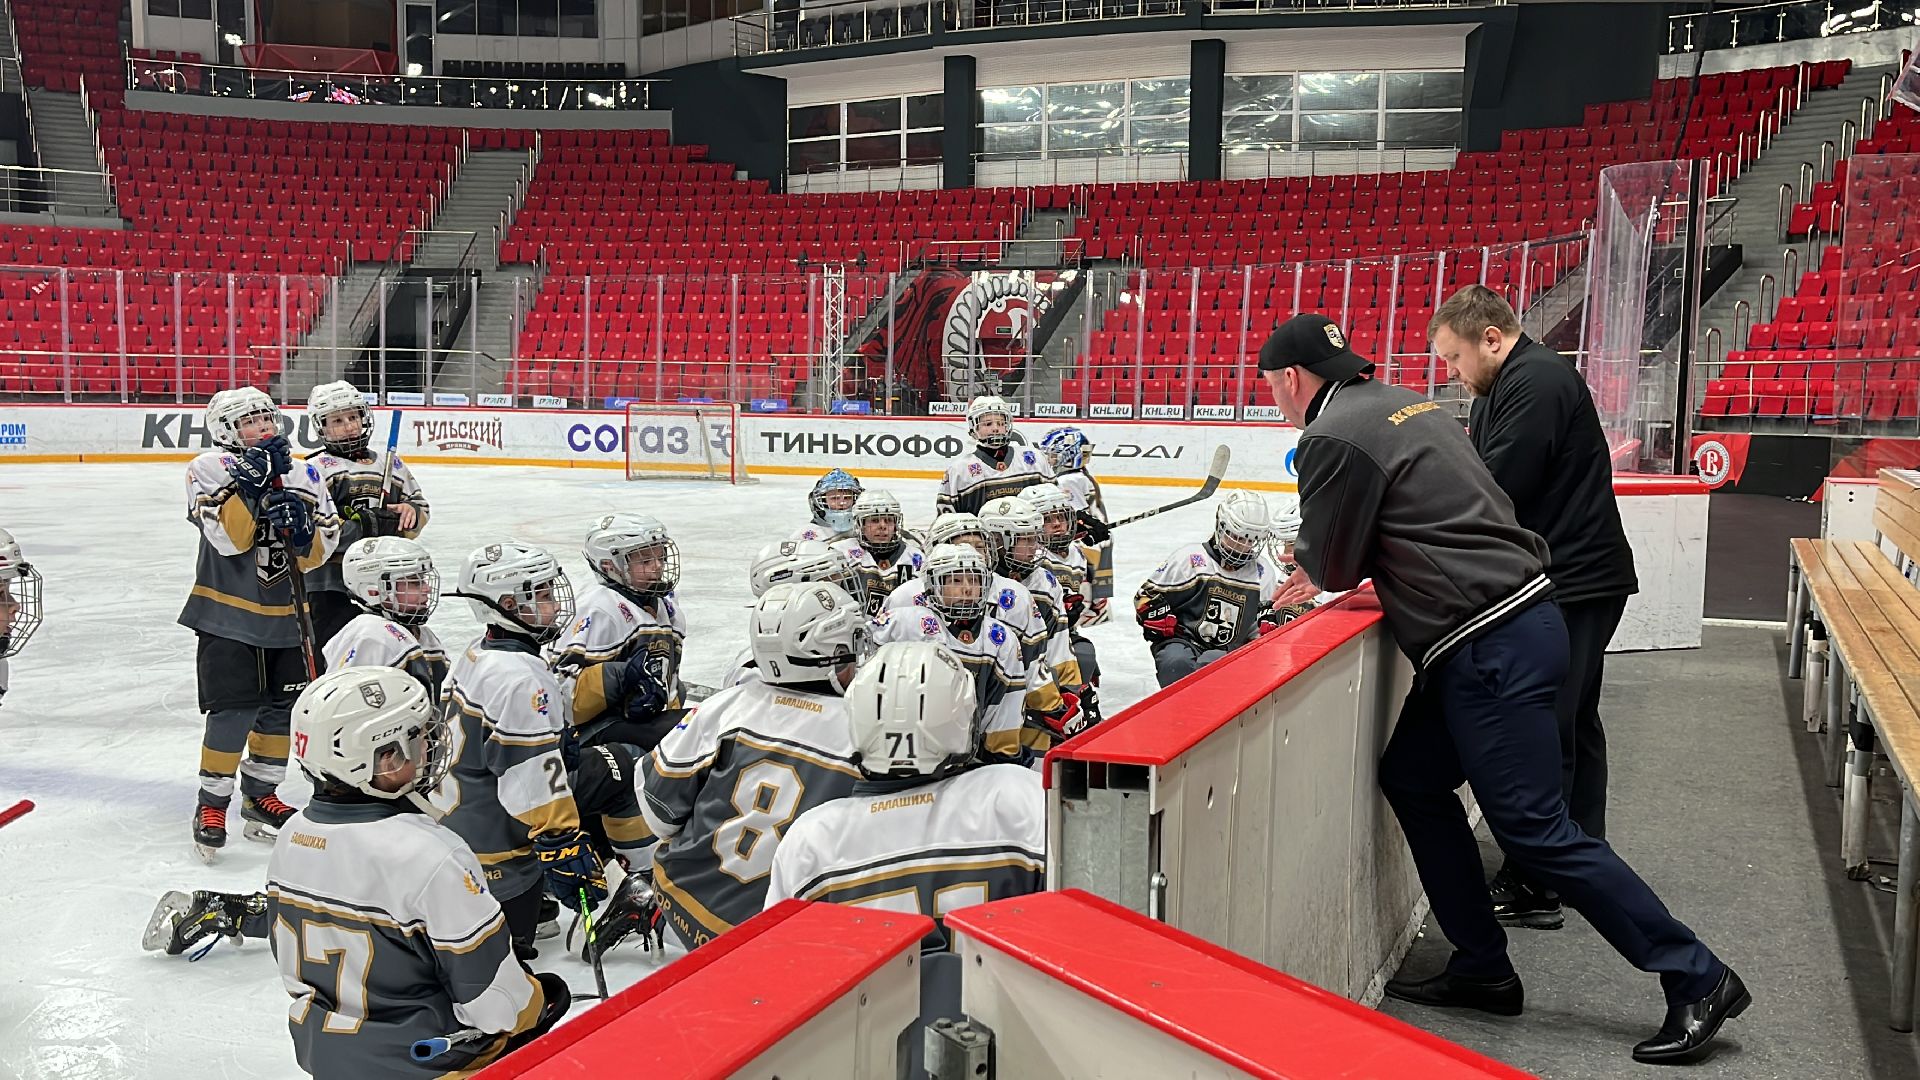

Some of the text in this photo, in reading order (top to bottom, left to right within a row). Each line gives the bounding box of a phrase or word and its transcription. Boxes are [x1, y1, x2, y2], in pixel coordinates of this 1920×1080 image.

[931, 402, 966, 412] KHL.RU
[1037, 404, 1074, 414] KHL.RU
[1092, 405, 1130, 415] KHL.RU
[1144, 407, 1181, 416] KHL.RU
[1196, 407, 1232, 417] KHL.RU
[1246, 408, 1281, 417] KHL.RU
[413, 417, 503, 450] ТУЛЬСКИЙ
[760, 432, 963, 459] ТИНЬКОФФ
[774, 696, 823, 713] БАЛАШИХА
[371, 725, 402, 742] CCM
[885, 732, 917, 758] 71
[870, 792, 935, 814] БАЛАШИХА
[711, 758, 805, 885] 8
[537, 845, 580, 862] CM
